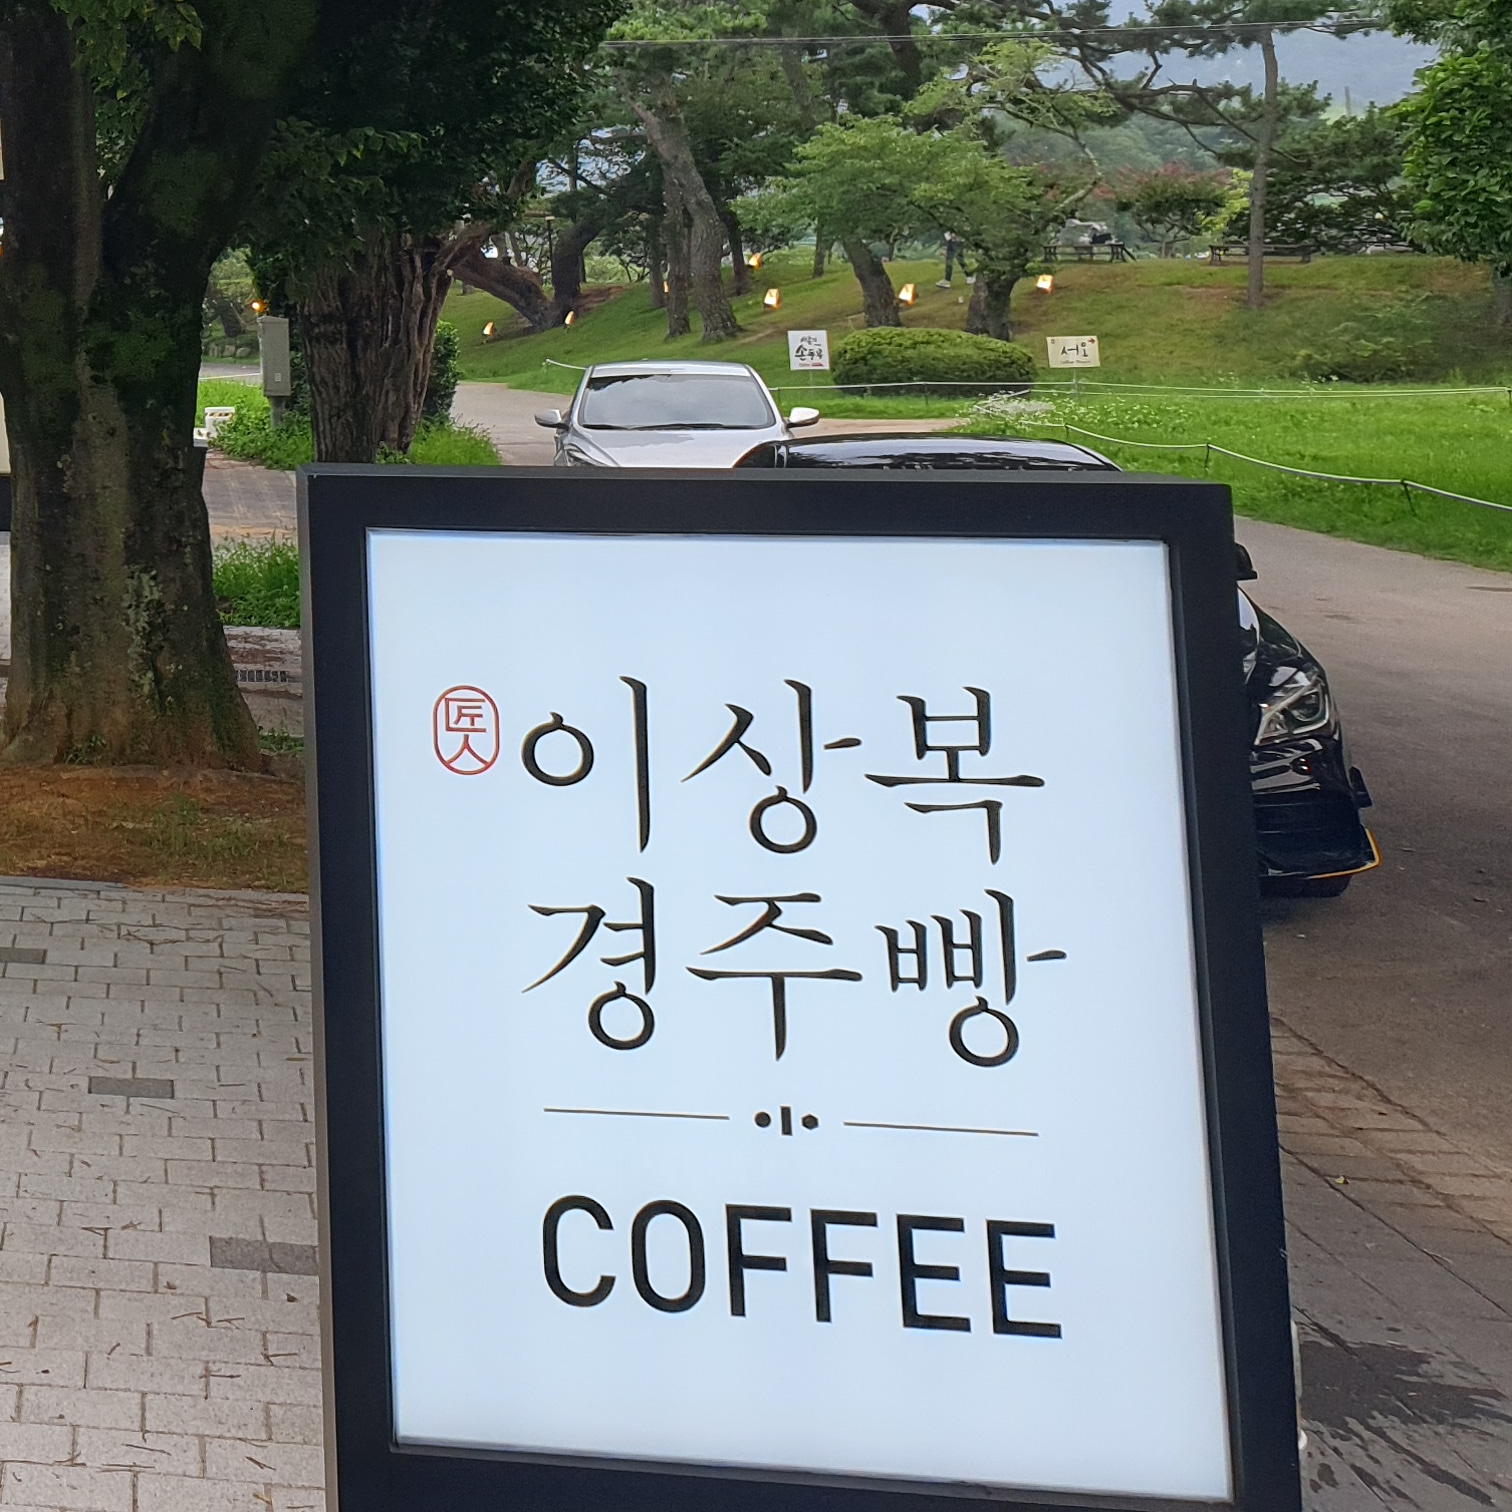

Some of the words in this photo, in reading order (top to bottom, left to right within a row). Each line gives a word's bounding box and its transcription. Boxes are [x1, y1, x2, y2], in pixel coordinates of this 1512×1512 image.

[521, 675, 1045, 865] 이상복
[521, 876, 1067, 1068] 경주빵
[541, 1194, 1063, 1339] COFFEE
